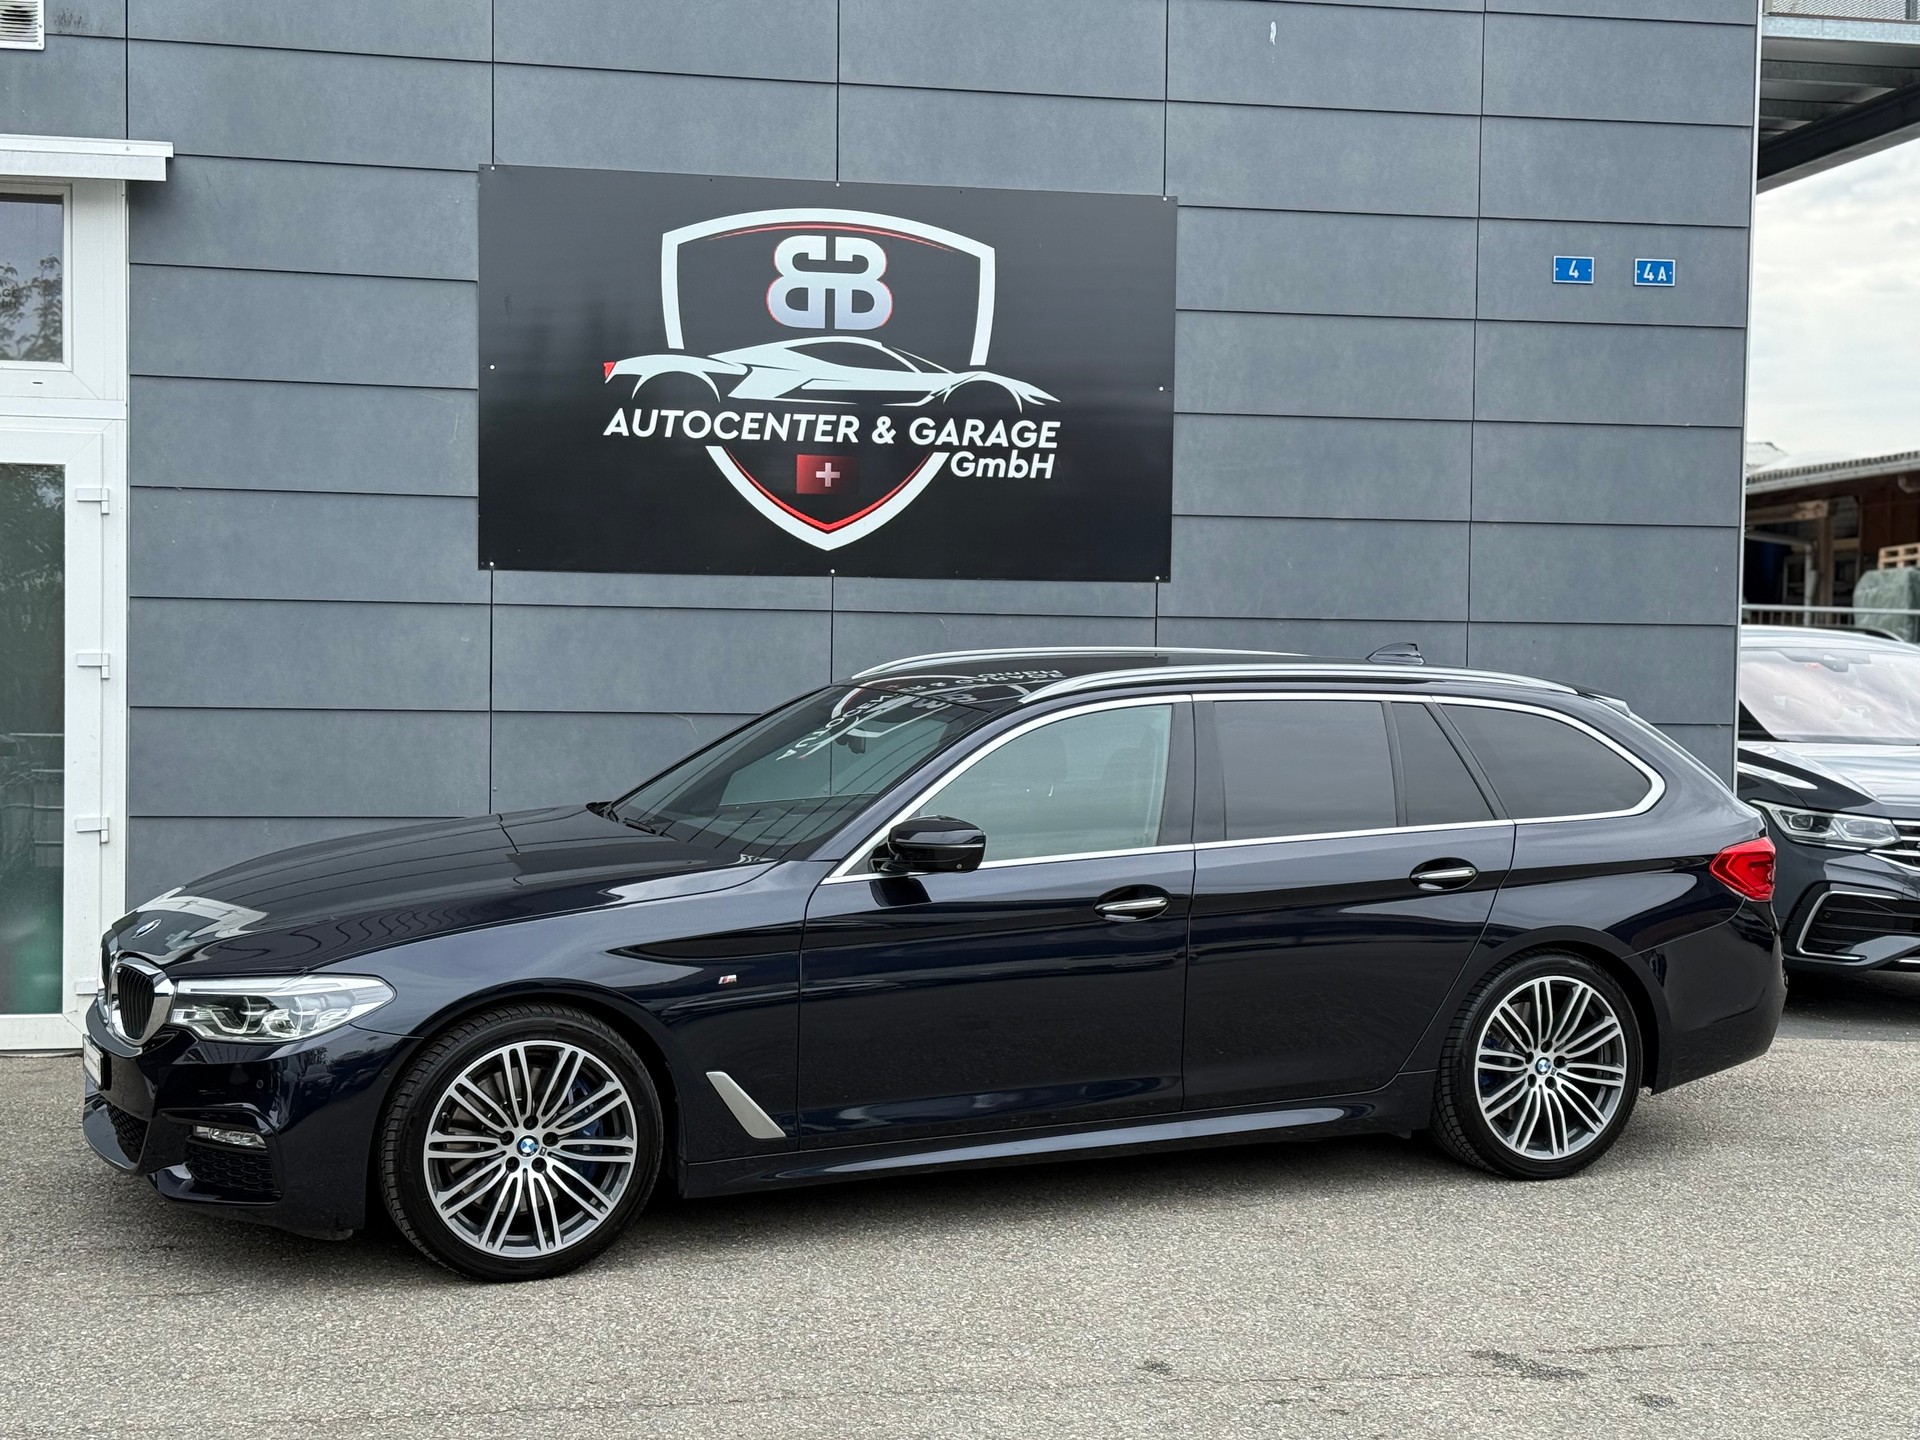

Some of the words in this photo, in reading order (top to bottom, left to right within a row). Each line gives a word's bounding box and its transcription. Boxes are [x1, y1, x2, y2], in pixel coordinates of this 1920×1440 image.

[1568, 259, 1580, 279] 4
[1643, 263, 1667, 282] 4A
[603, 407, 860, 444] AUTOCENTER
[871, 415, 897, 445] &
[909, 416, 1061, 449] GARAGE
[950, 449, 1056, 480] GmbH
